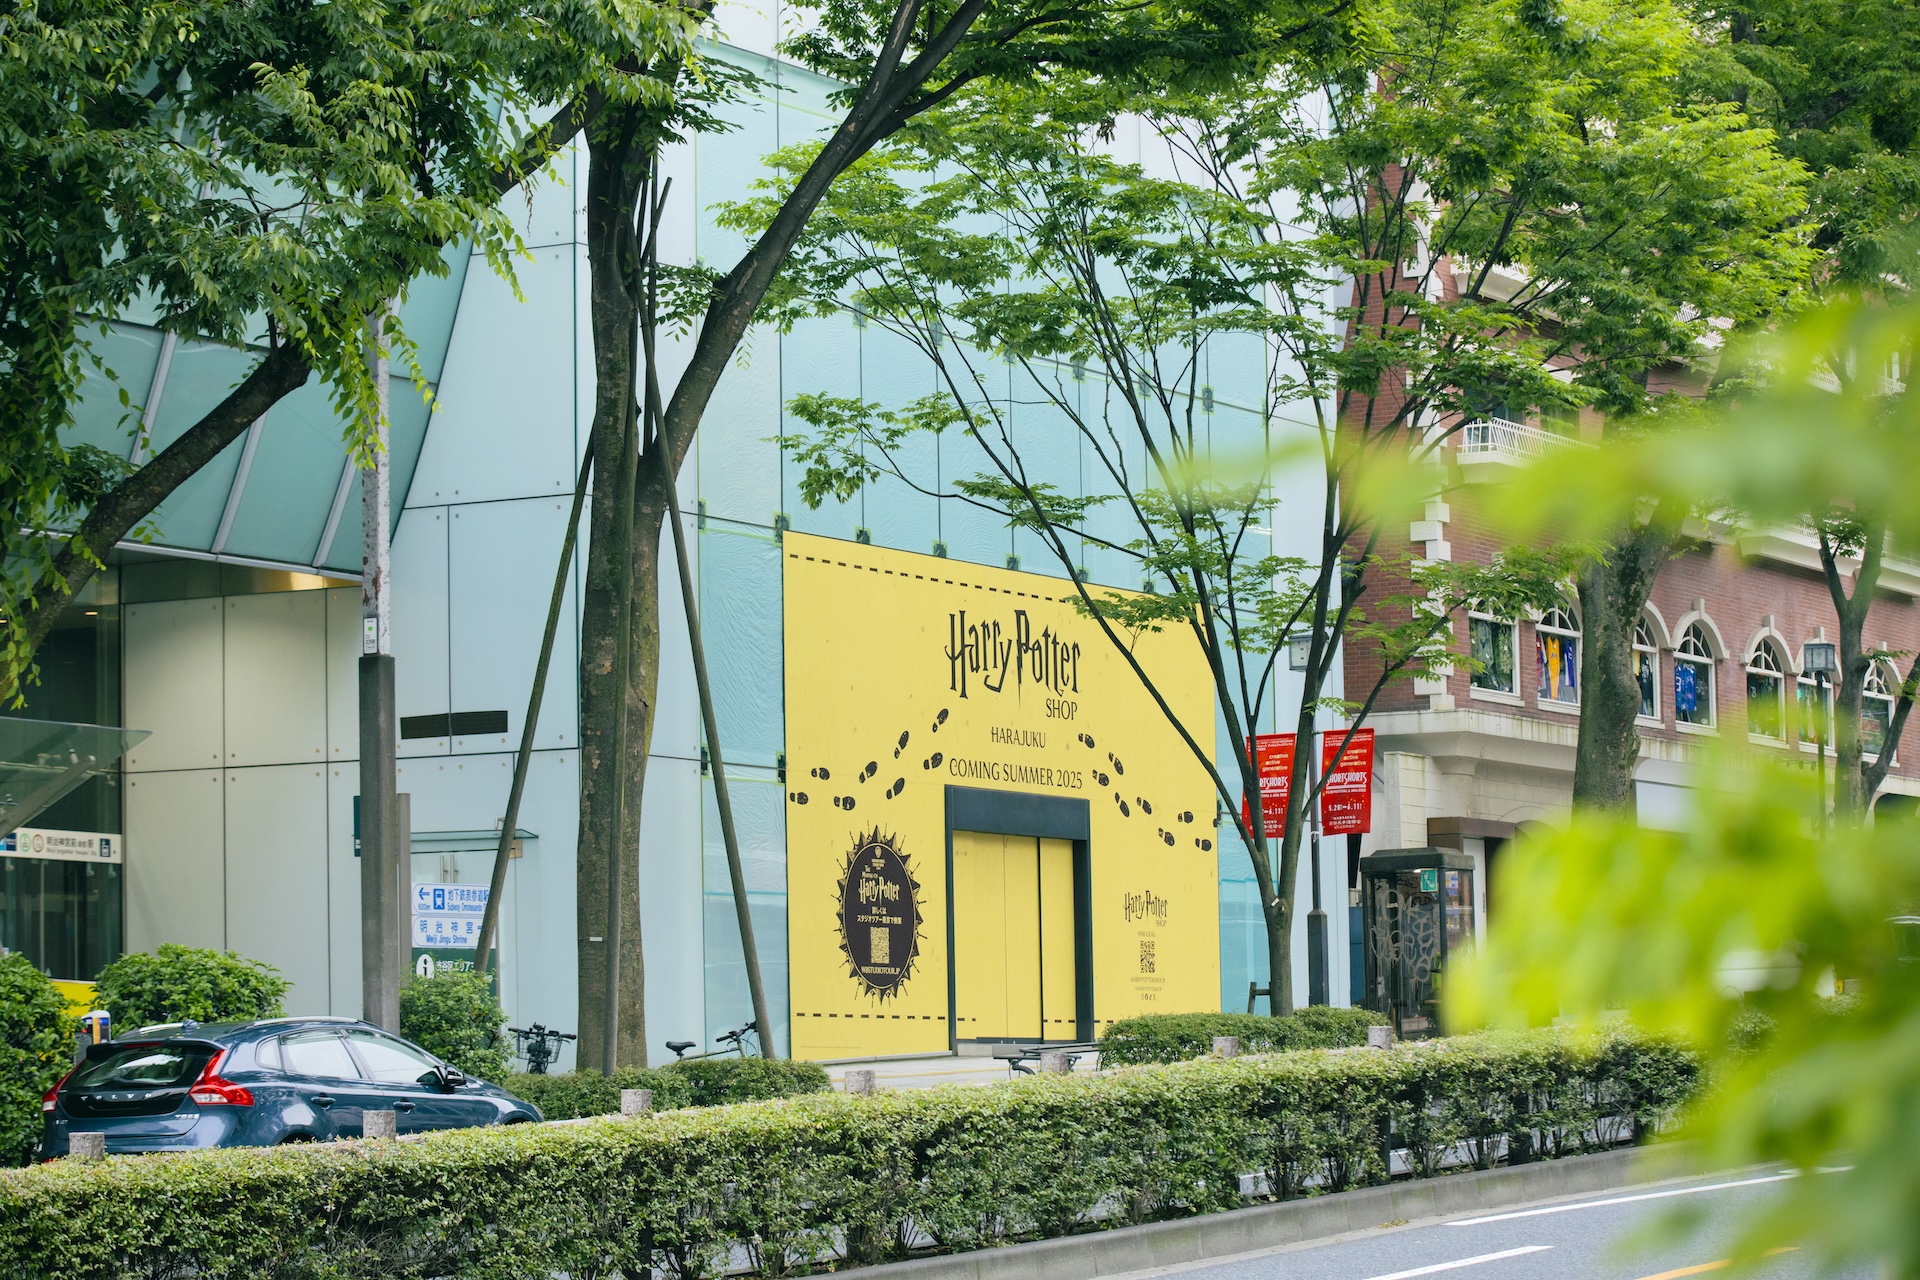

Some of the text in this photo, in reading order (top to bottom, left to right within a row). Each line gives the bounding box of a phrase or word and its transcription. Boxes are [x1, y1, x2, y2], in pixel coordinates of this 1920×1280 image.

[944, 610, 1081, 711] Harry Potter
[1045, 698, 1078, 720] SHOP
[990, 726, 1046, 748] HARAJUKU
[949, 758, 1083, 789] COMING SUMMER 2025
[858, 876, 900, 906] Harry Potter
[447, 902, 460, 912] Subway
[462, 903, 482, 912] Omotesando
[1123, 890, 1168, 922] Harry Potter
[426, 934, 467, 945] Meiji Jingu Shrine
[80, 1093, 152, 1101] VOLVO
